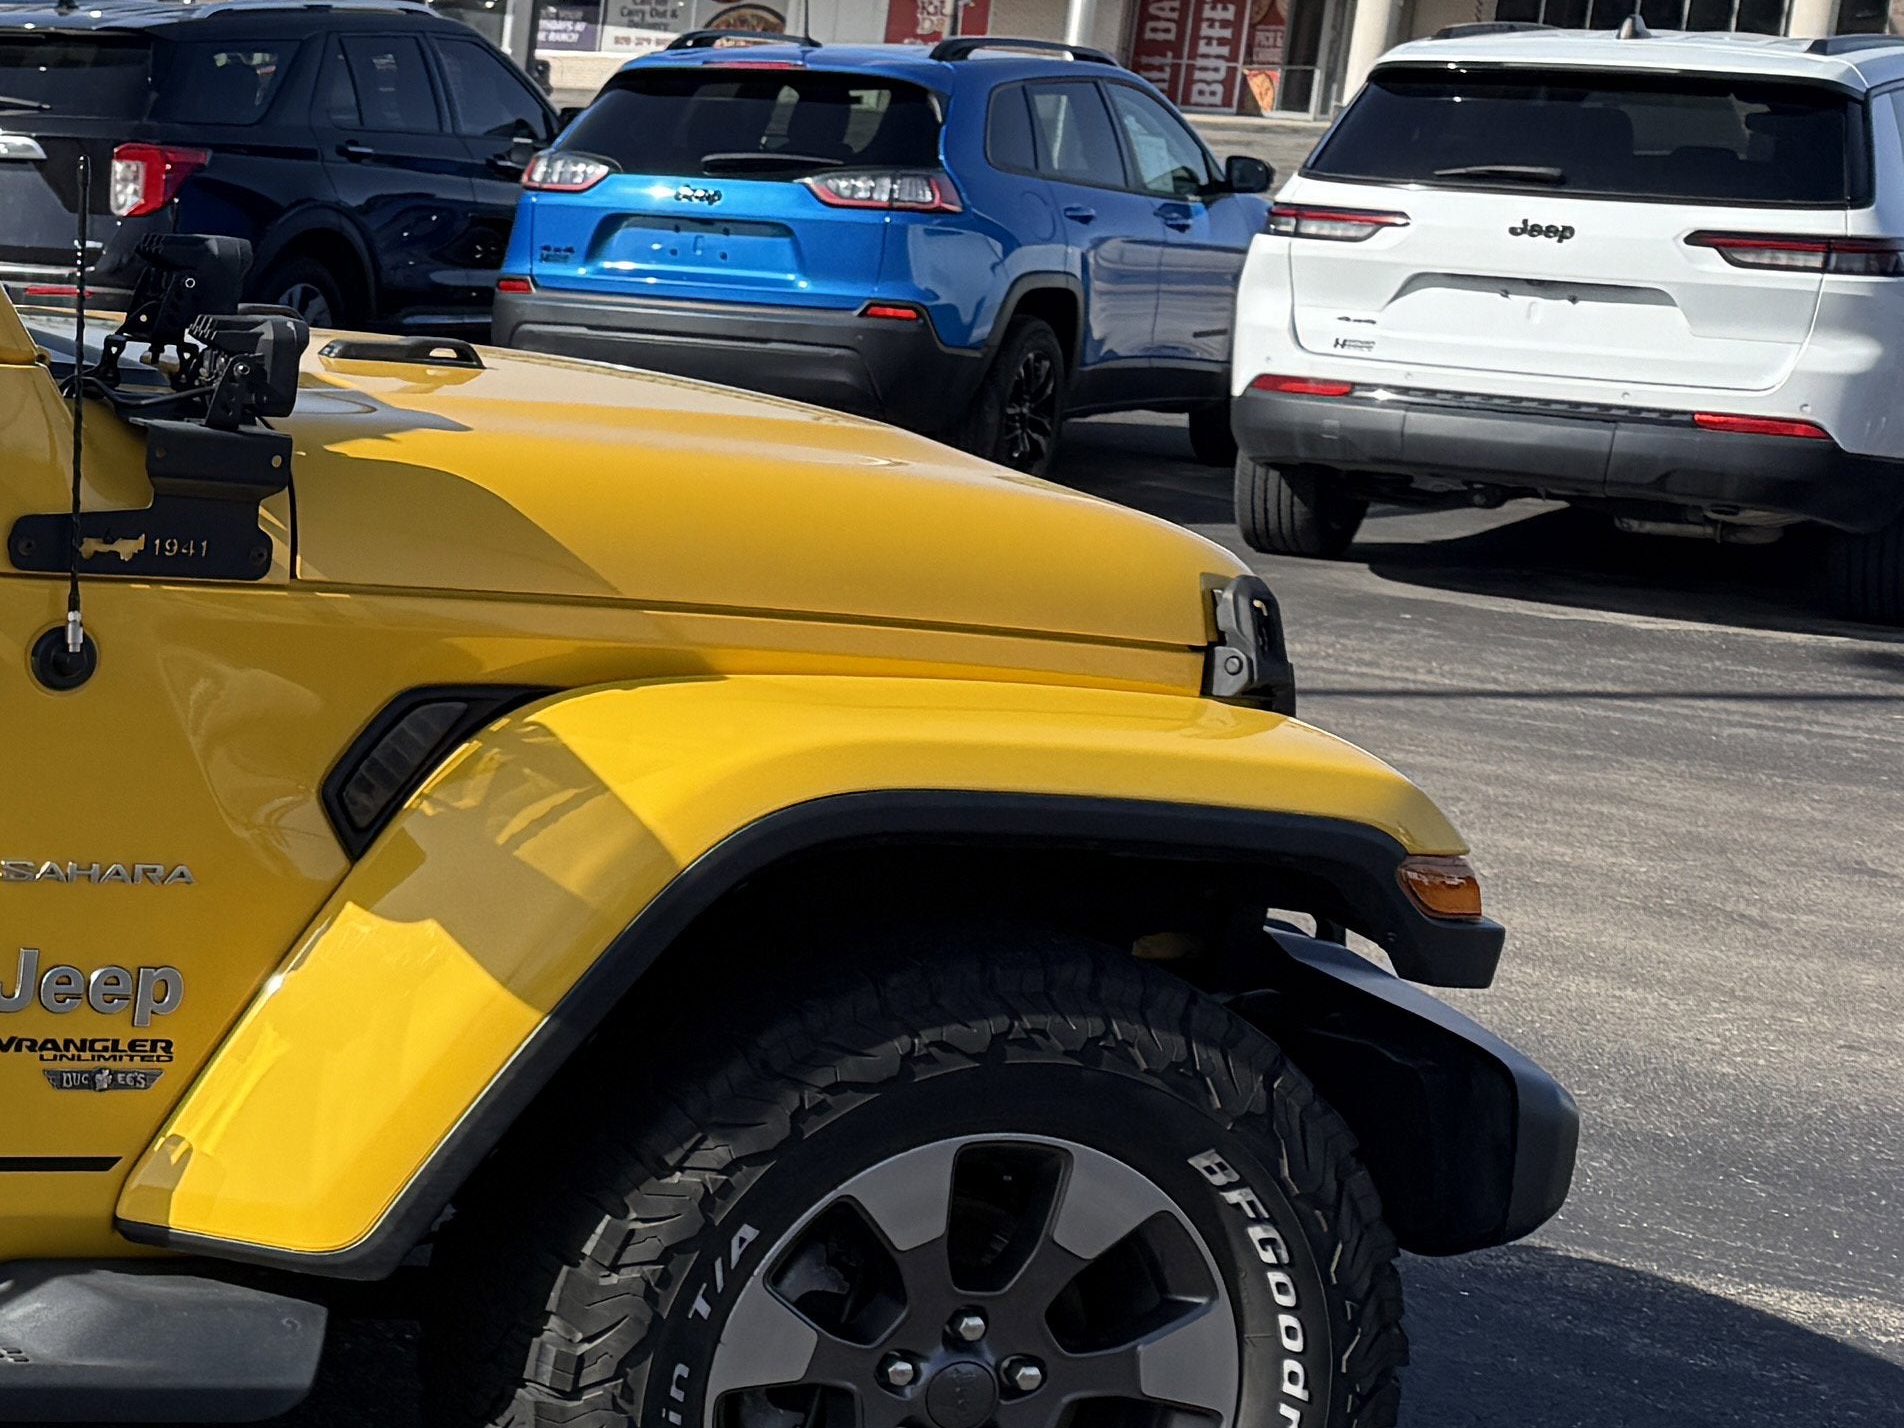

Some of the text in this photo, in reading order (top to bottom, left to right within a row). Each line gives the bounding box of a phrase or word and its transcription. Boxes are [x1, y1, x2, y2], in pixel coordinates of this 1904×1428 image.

[1508, 218, 1576, 243] Jeep
[153, 538, 208, 558] 1941
[38, 1053, 174, 1063] UNLIMITED
[688, 1223, 760, 1322] T/A
